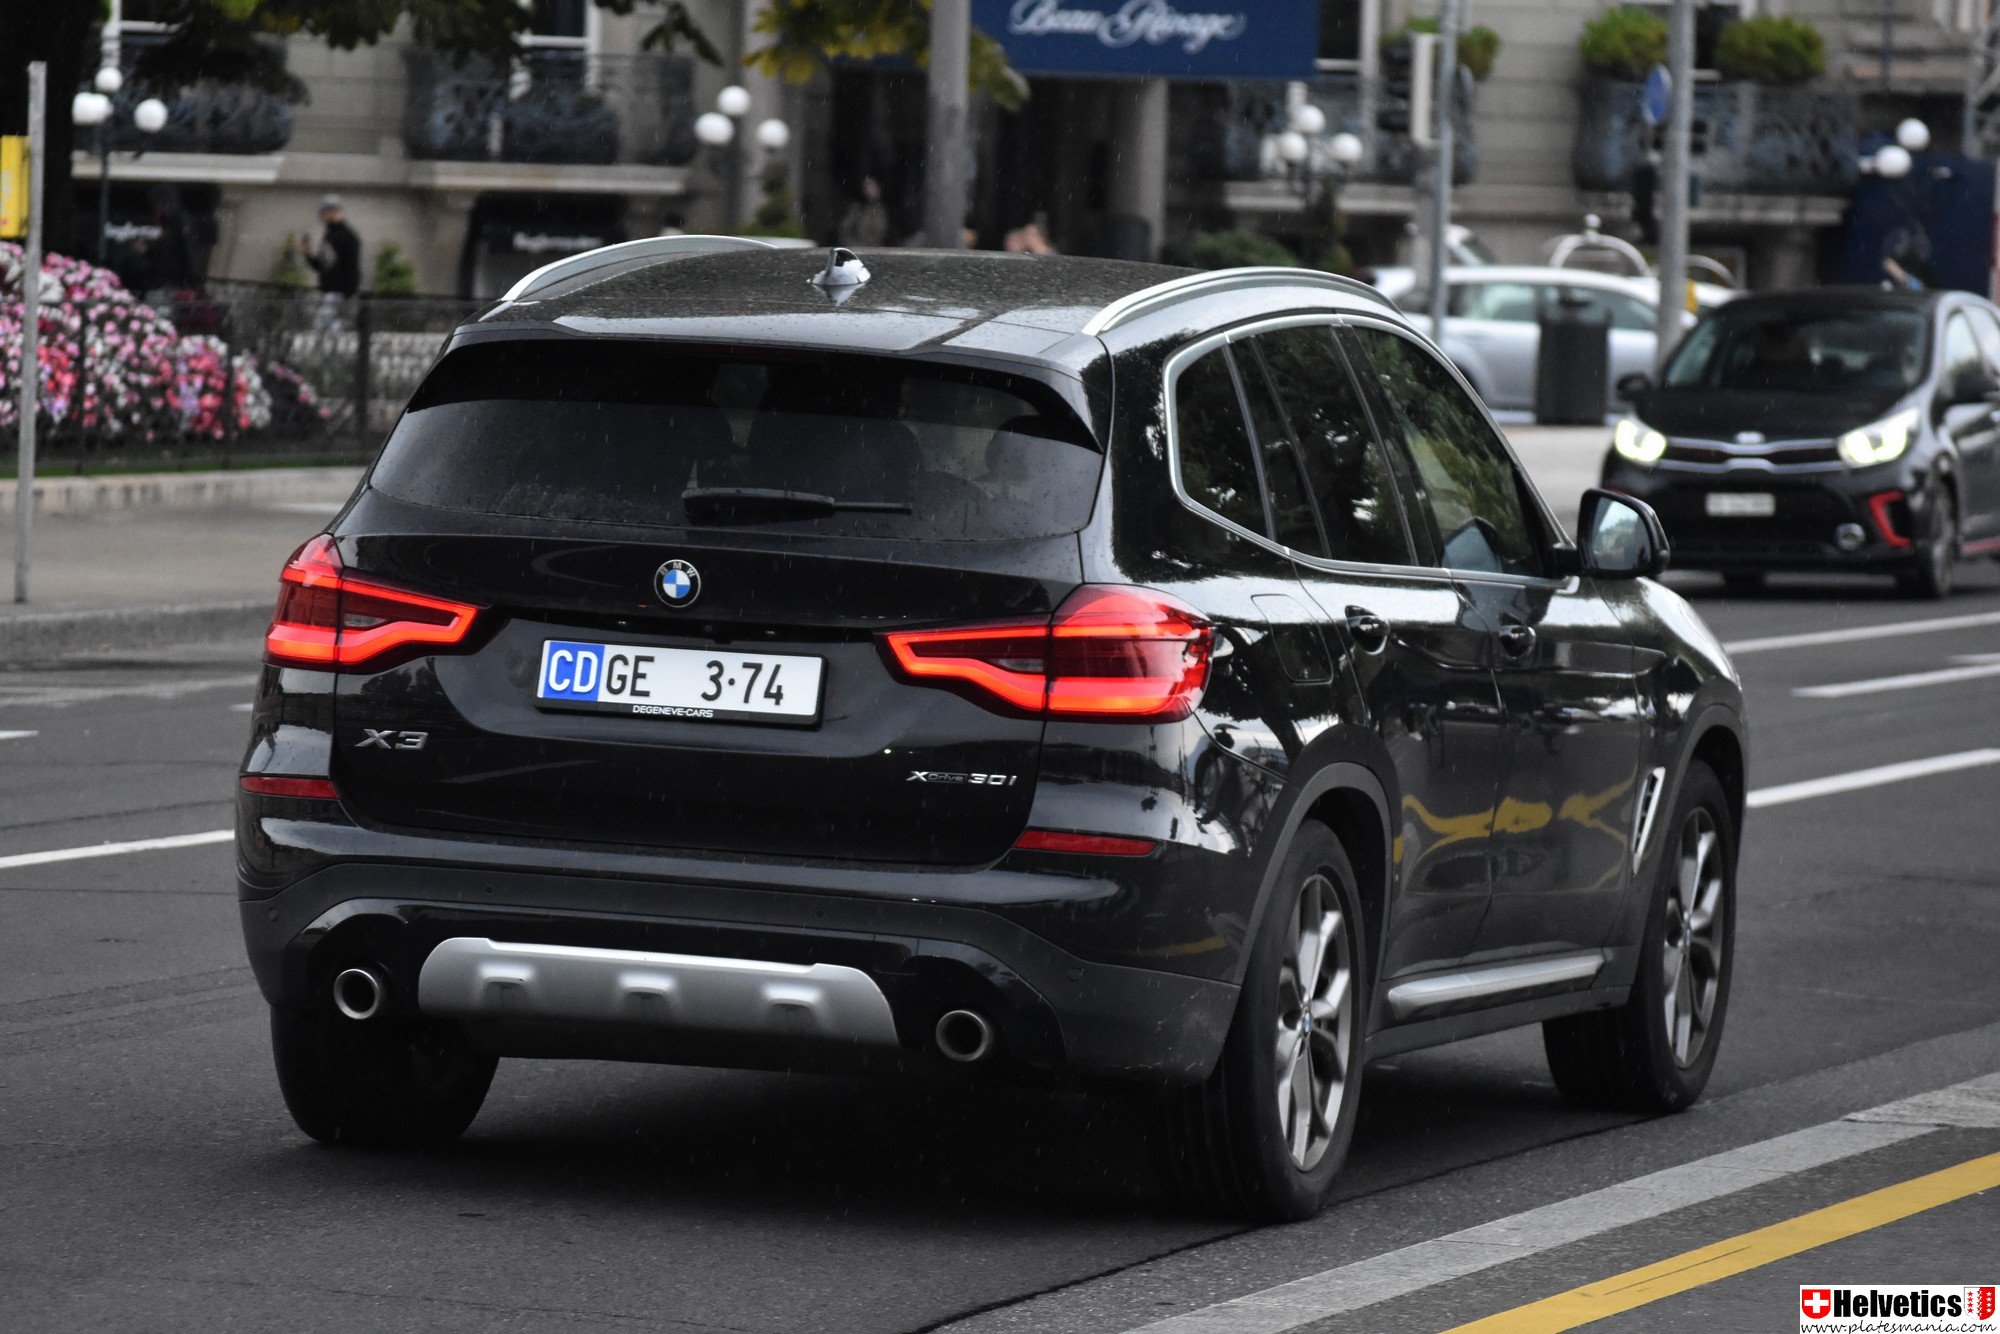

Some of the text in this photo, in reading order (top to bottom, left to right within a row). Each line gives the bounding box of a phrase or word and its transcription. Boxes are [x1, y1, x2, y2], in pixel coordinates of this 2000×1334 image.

[660, 561, 696, 577] BMW
[548, 649, 599, 693] CD
[606, 653, 655, 697] GE
[632, 704, 714, 718] DEGENEVE-CARS
[354, 728, 429, 750] X3
